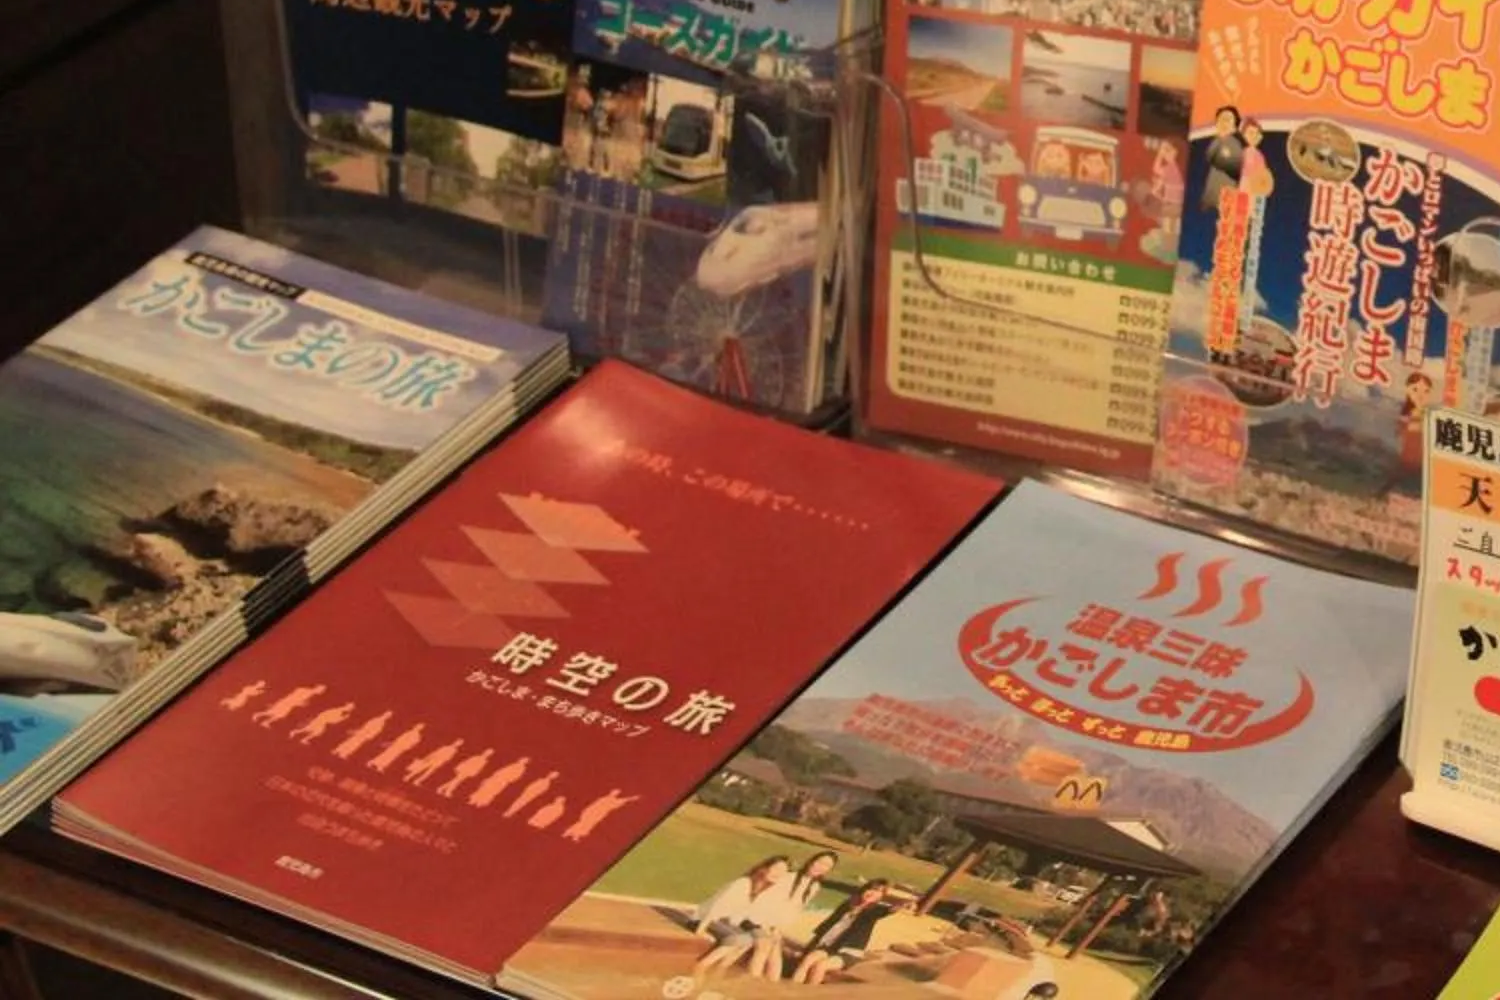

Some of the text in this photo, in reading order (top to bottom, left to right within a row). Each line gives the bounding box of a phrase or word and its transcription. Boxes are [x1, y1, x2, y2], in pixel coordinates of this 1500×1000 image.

[1282, 26, 1491, 129] かごしま
[1293, 178, 1364, 408] 時遊紀行
[1352, 147, 1424, 385] かごしま
[120, 272, 475, 412] かごしまの旅
[491, 631, 736, 735] 時空の旅
[979, 626, 1264, 736] かごしま市
